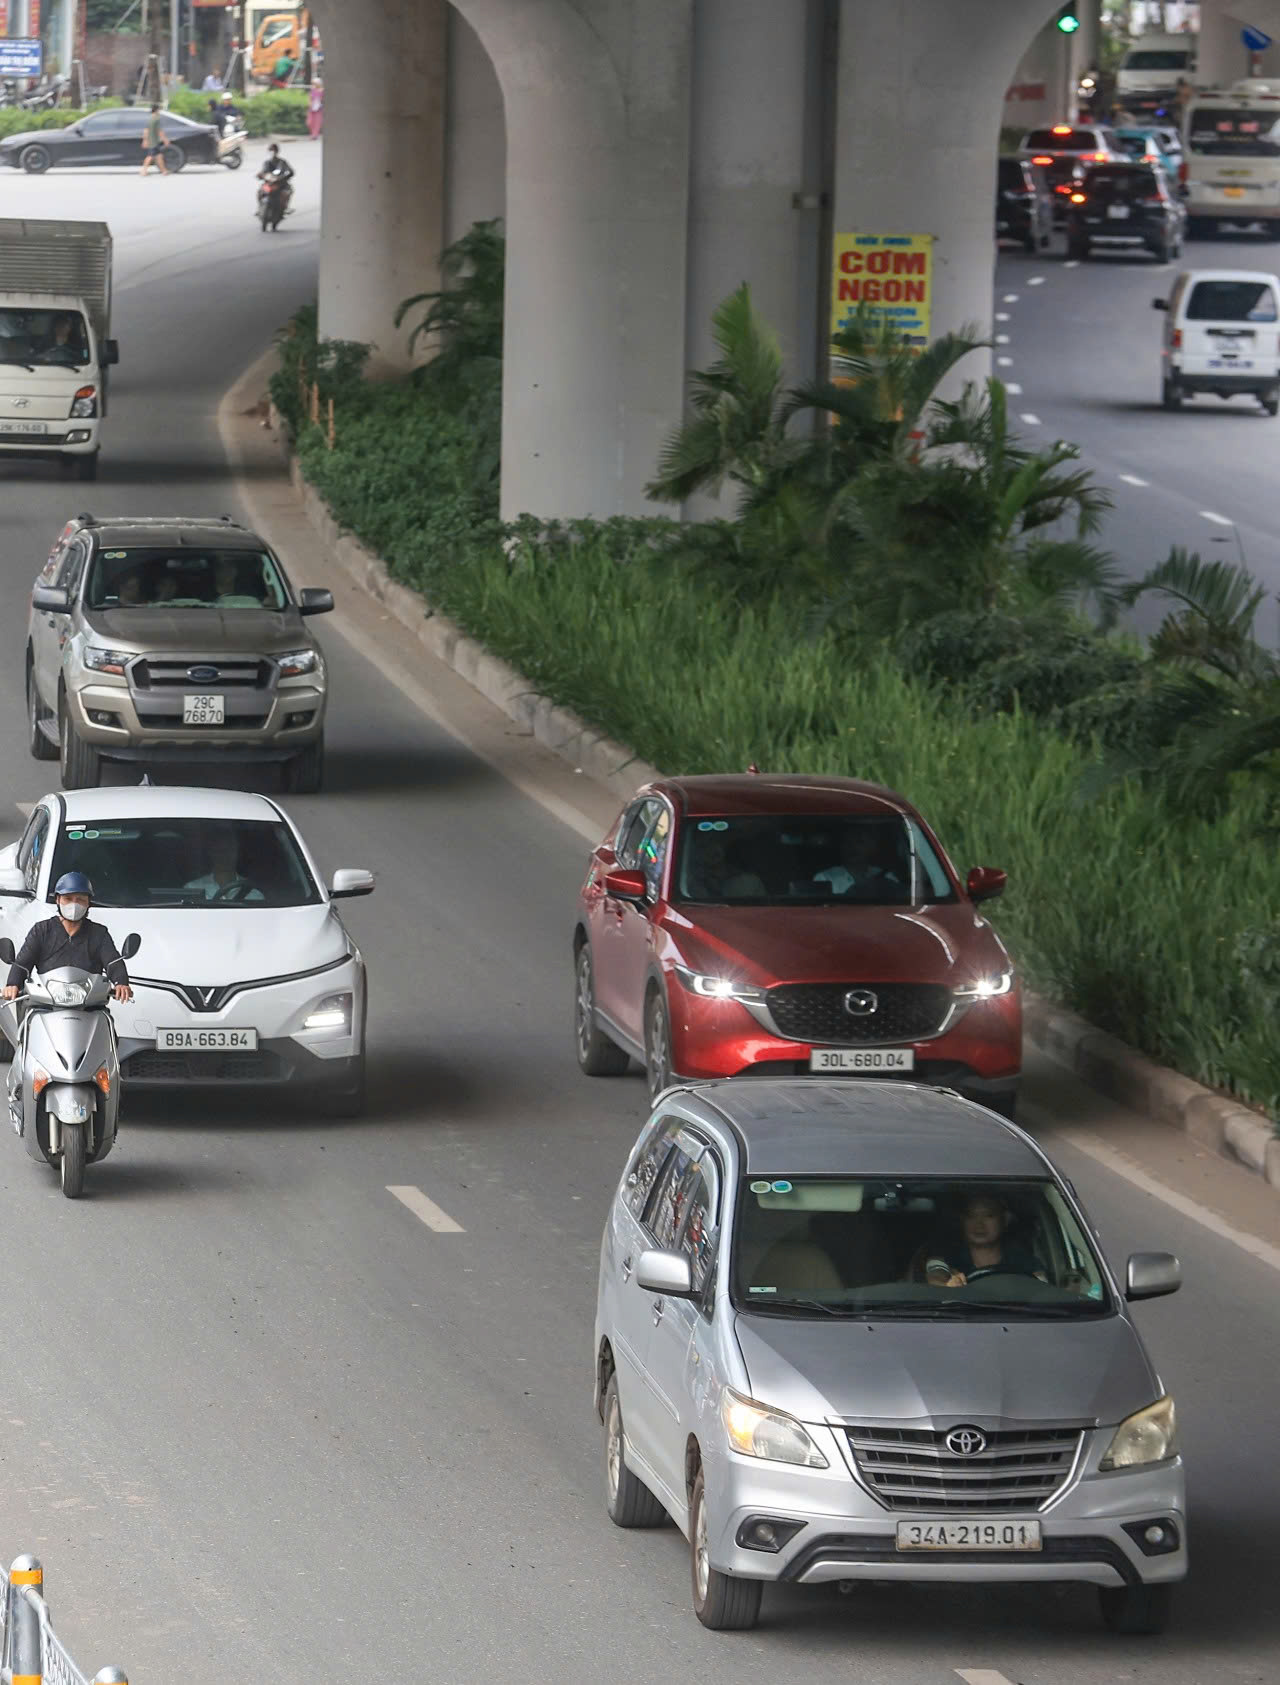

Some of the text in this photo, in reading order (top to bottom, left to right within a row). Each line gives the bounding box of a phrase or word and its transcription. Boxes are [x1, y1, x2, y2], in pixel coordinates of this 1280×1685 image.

[840, 250, 926, 275] CƠM
[194, 696, 215, 709] 29C
[165, 1033, 248, 1046] 89A-663.84
[821, 1053, 904, 1067] 30L-680.04
[909, 1525, 1026, 1544] 34A-219.01
